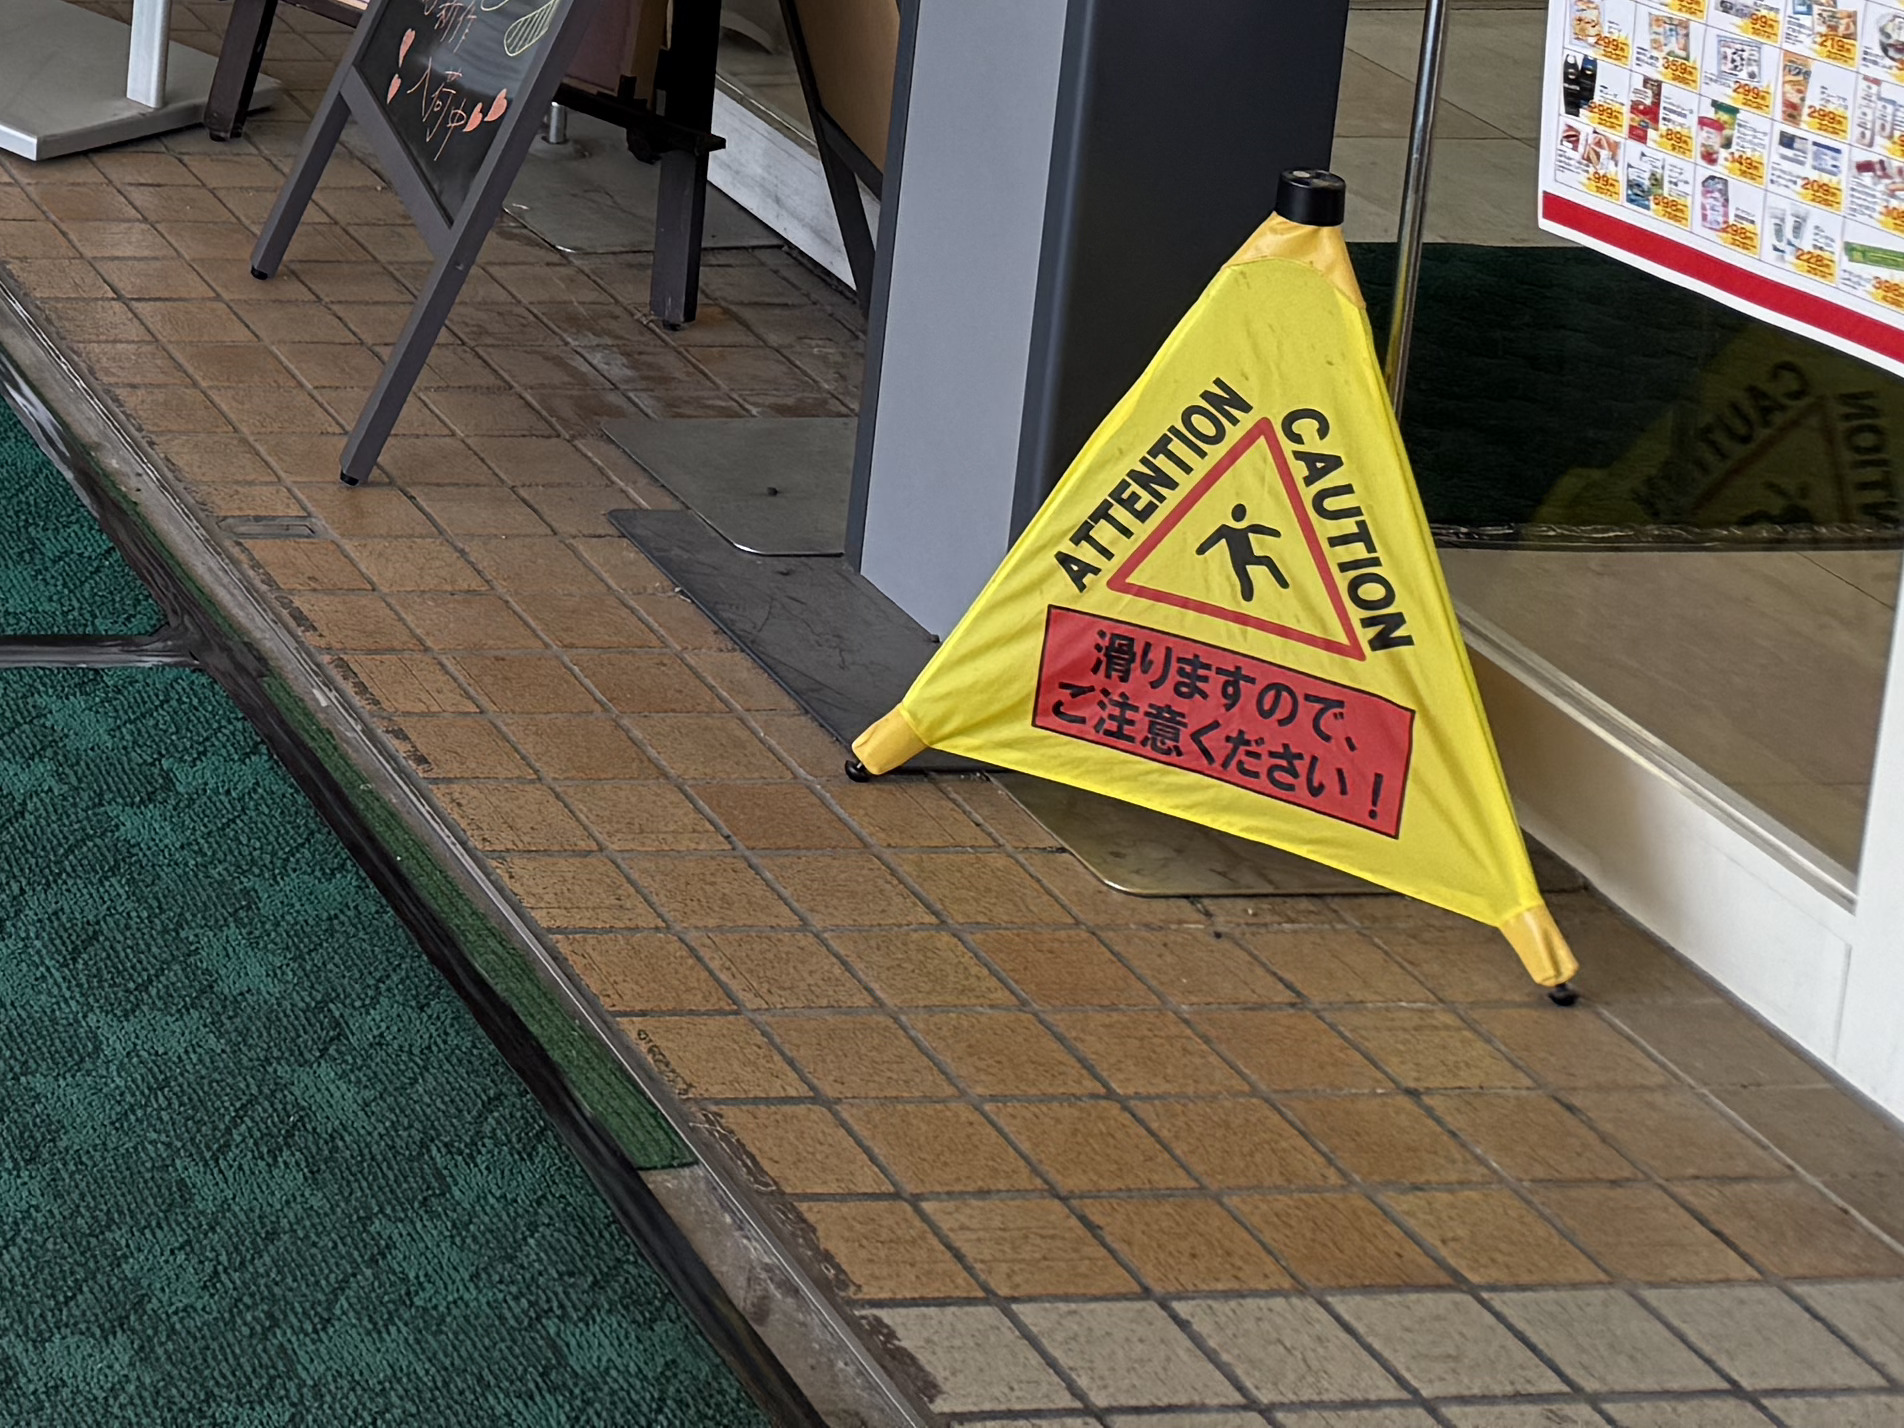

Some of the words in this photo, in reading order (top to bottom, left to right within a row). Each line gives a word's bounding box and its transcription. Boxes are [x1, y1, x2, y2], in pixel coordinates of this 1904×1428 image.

[1054, 376, 1253, 593] ATTENTION
[1280, 408, 1415, 652] CAUTION
[1094, 629, 1357, 751] 滑りますので、
